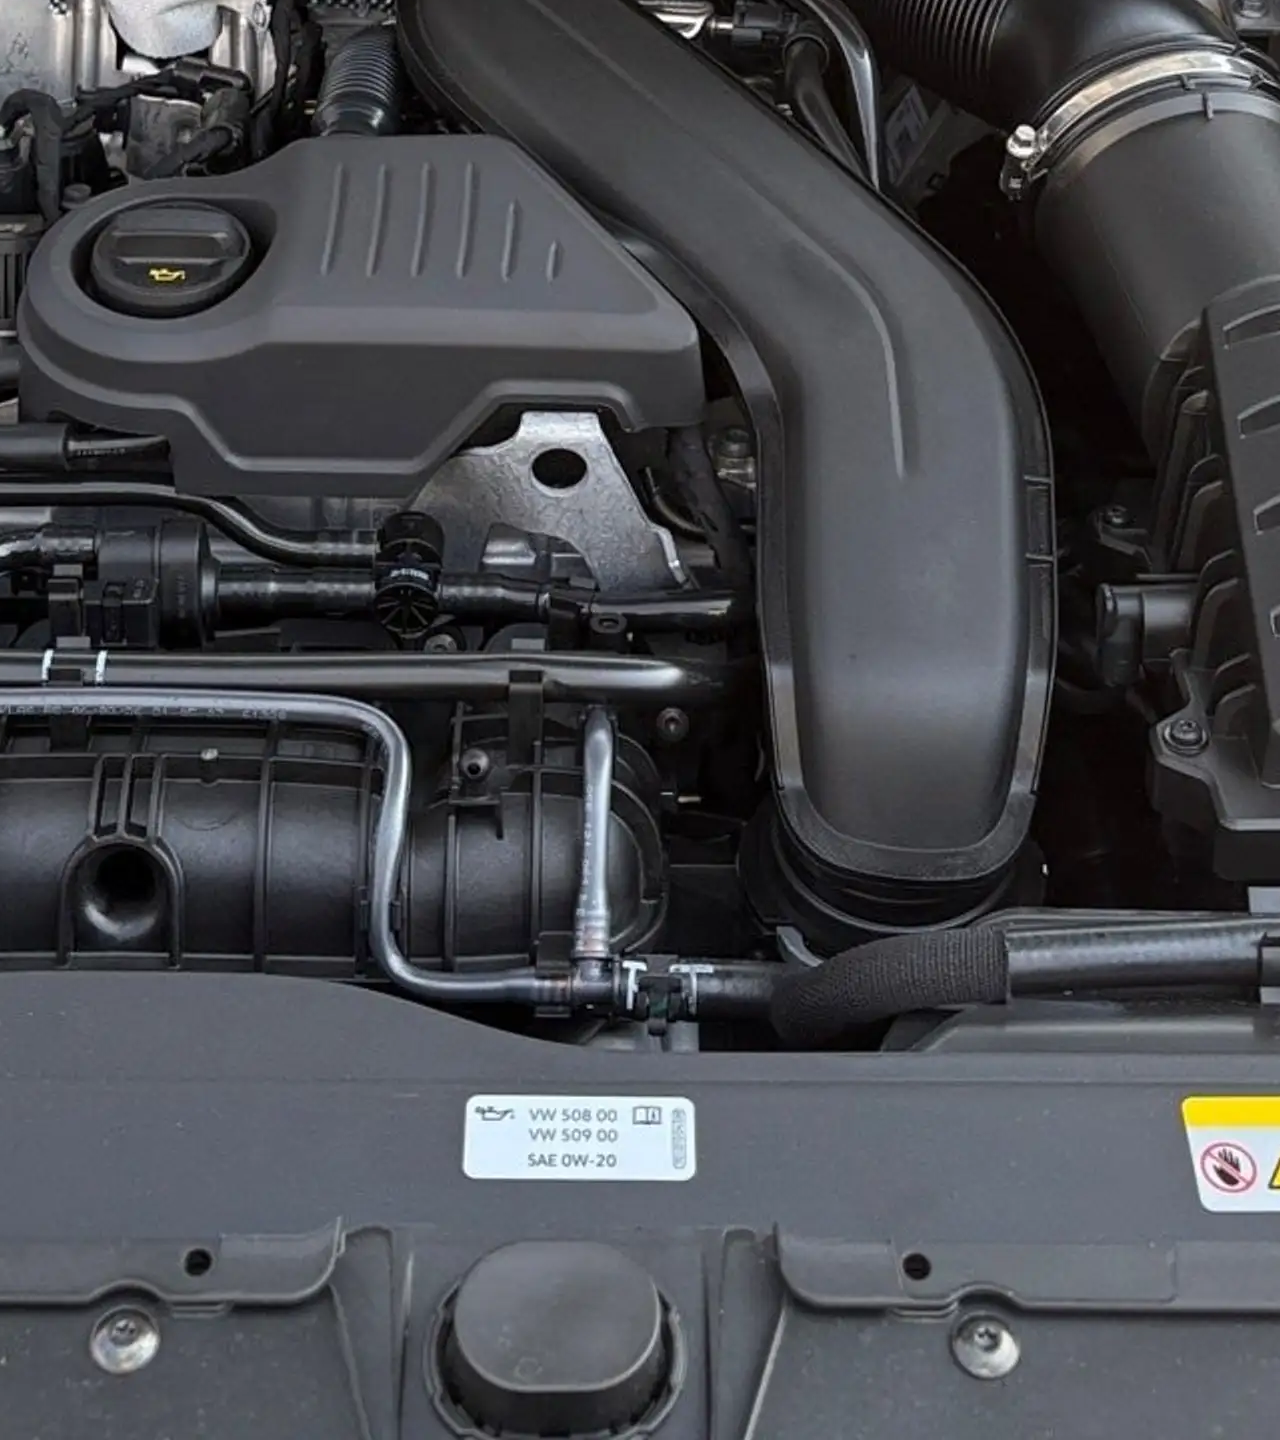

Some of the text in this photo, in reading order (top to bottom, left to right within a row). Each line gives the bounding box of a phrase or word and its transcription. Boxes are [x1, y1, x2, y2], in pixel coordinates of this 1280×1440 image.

[529, 1108, 619, 1123] VW 508 00
[529, 1128, 619, 1143] VW 509 00
[527, 1153, 618, 1168] SAE 0W-20
